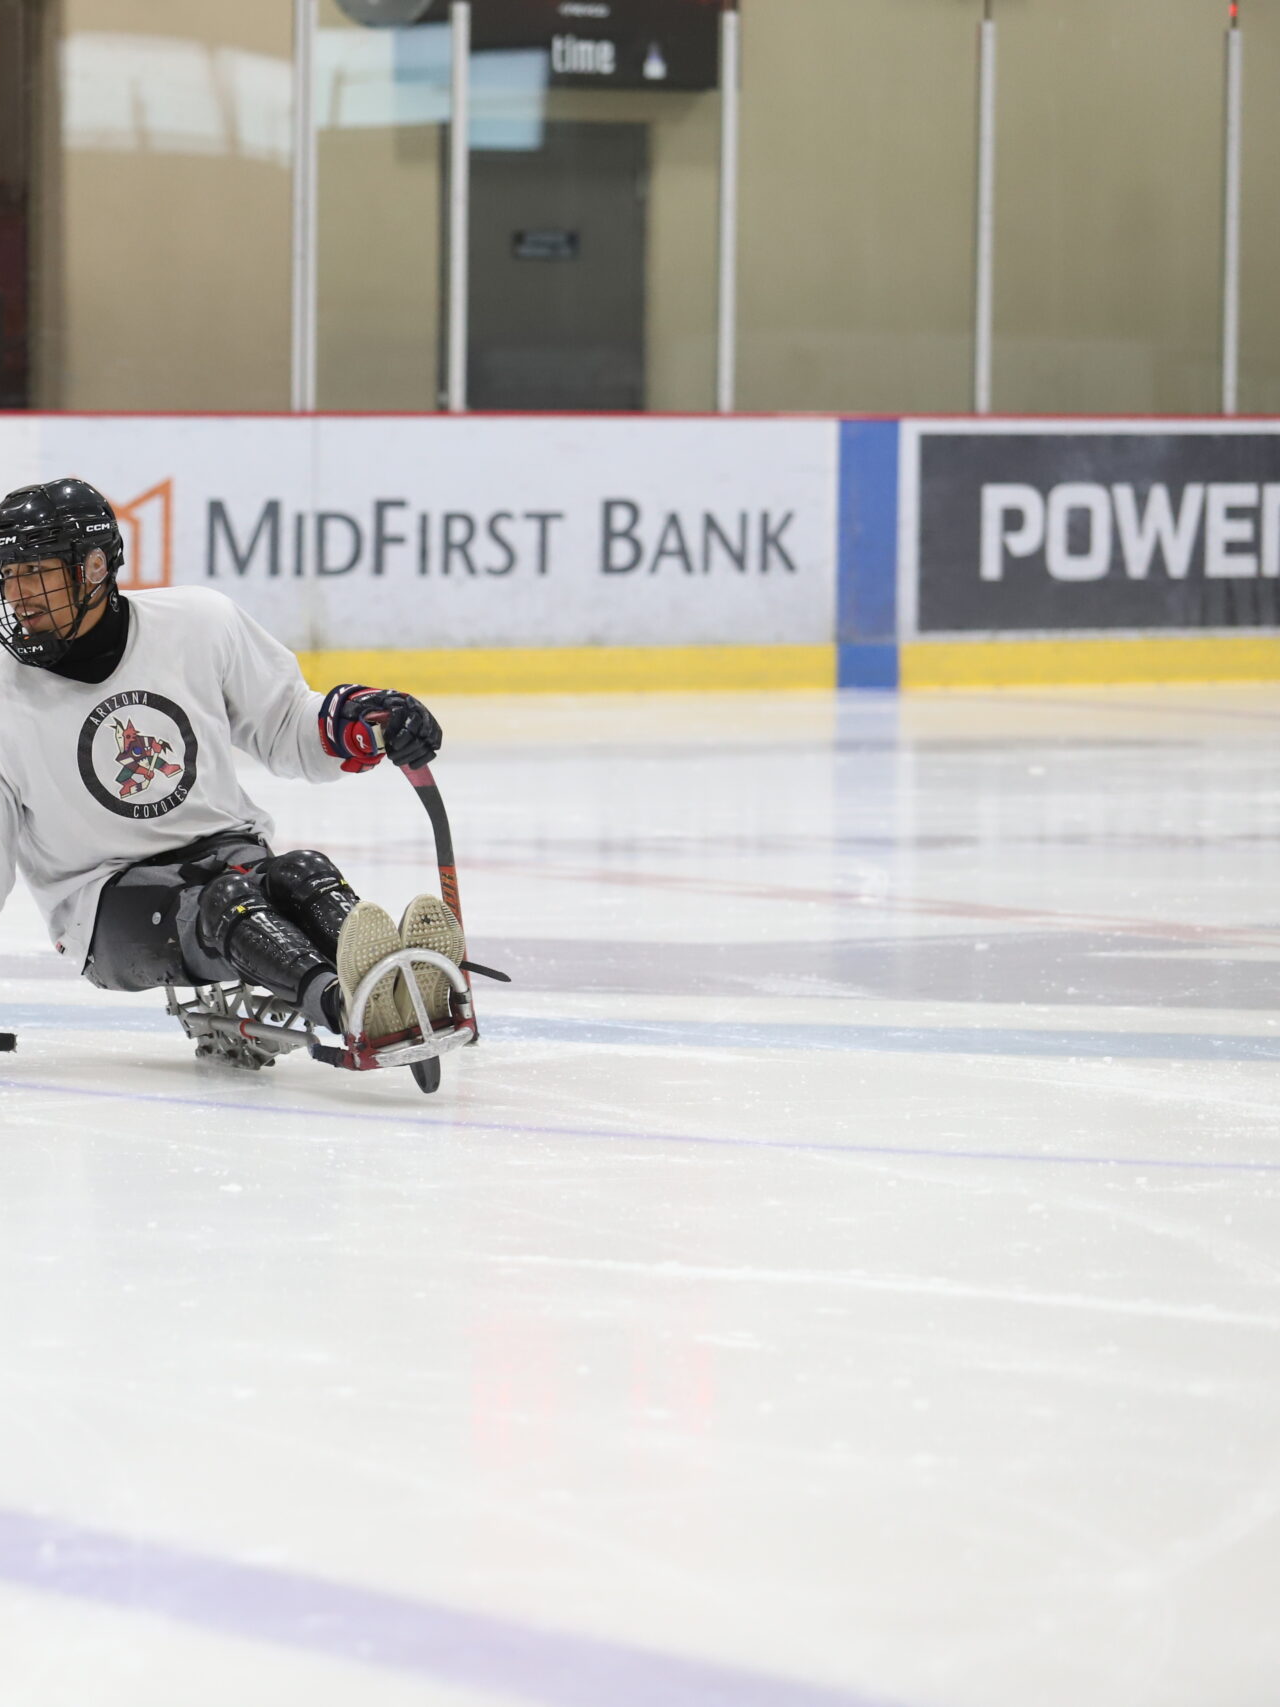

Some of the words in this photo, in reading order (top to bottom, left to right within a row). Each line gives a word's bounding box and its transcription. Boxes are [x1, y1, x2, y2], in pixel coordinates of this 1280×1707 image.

[86, 523, 111, 532] CCM
[17, 645, 44, 654] CCM
[89, 692, 148, 726] ARIZONA
[133, 784, 188, 818] COYOTES
